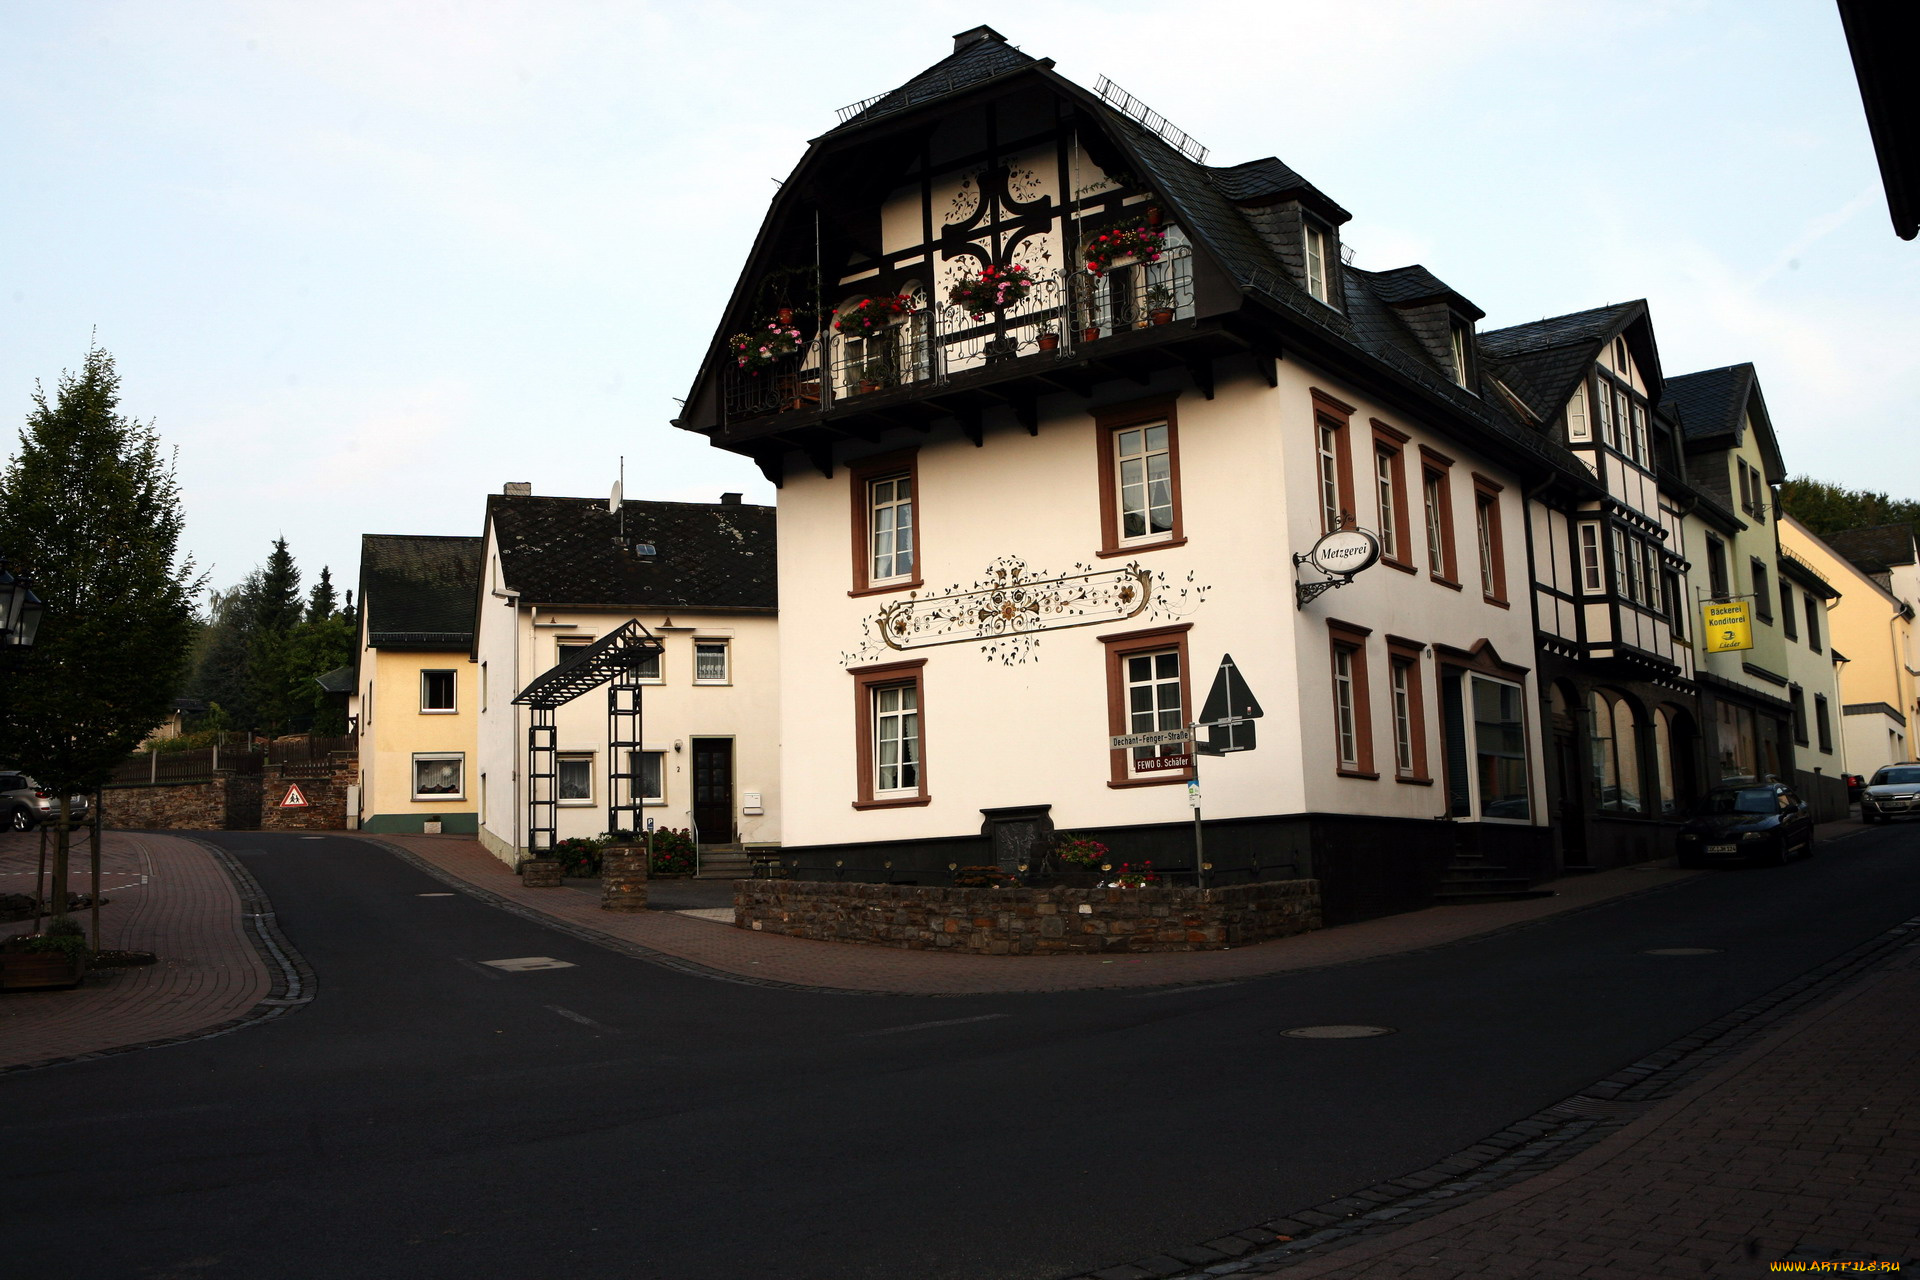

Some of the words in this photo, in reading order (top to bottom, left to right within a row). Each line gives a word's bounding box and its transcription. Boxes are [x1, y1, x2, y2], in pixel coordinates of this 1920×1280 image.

[1321, 543, 1367, 560] Metzgerei
[1710, 606, 1741, 616] Bäckerei
[1709, 615, 1745, 626] Konditorei
[1113, 731, 1188, 746] Dechant-Fenger-Straße
[1137, 760, 1155, 770] FEWO
[1156, 759, 1163, 767] G.
[1164, 757, 1188, 767] Schäfer
